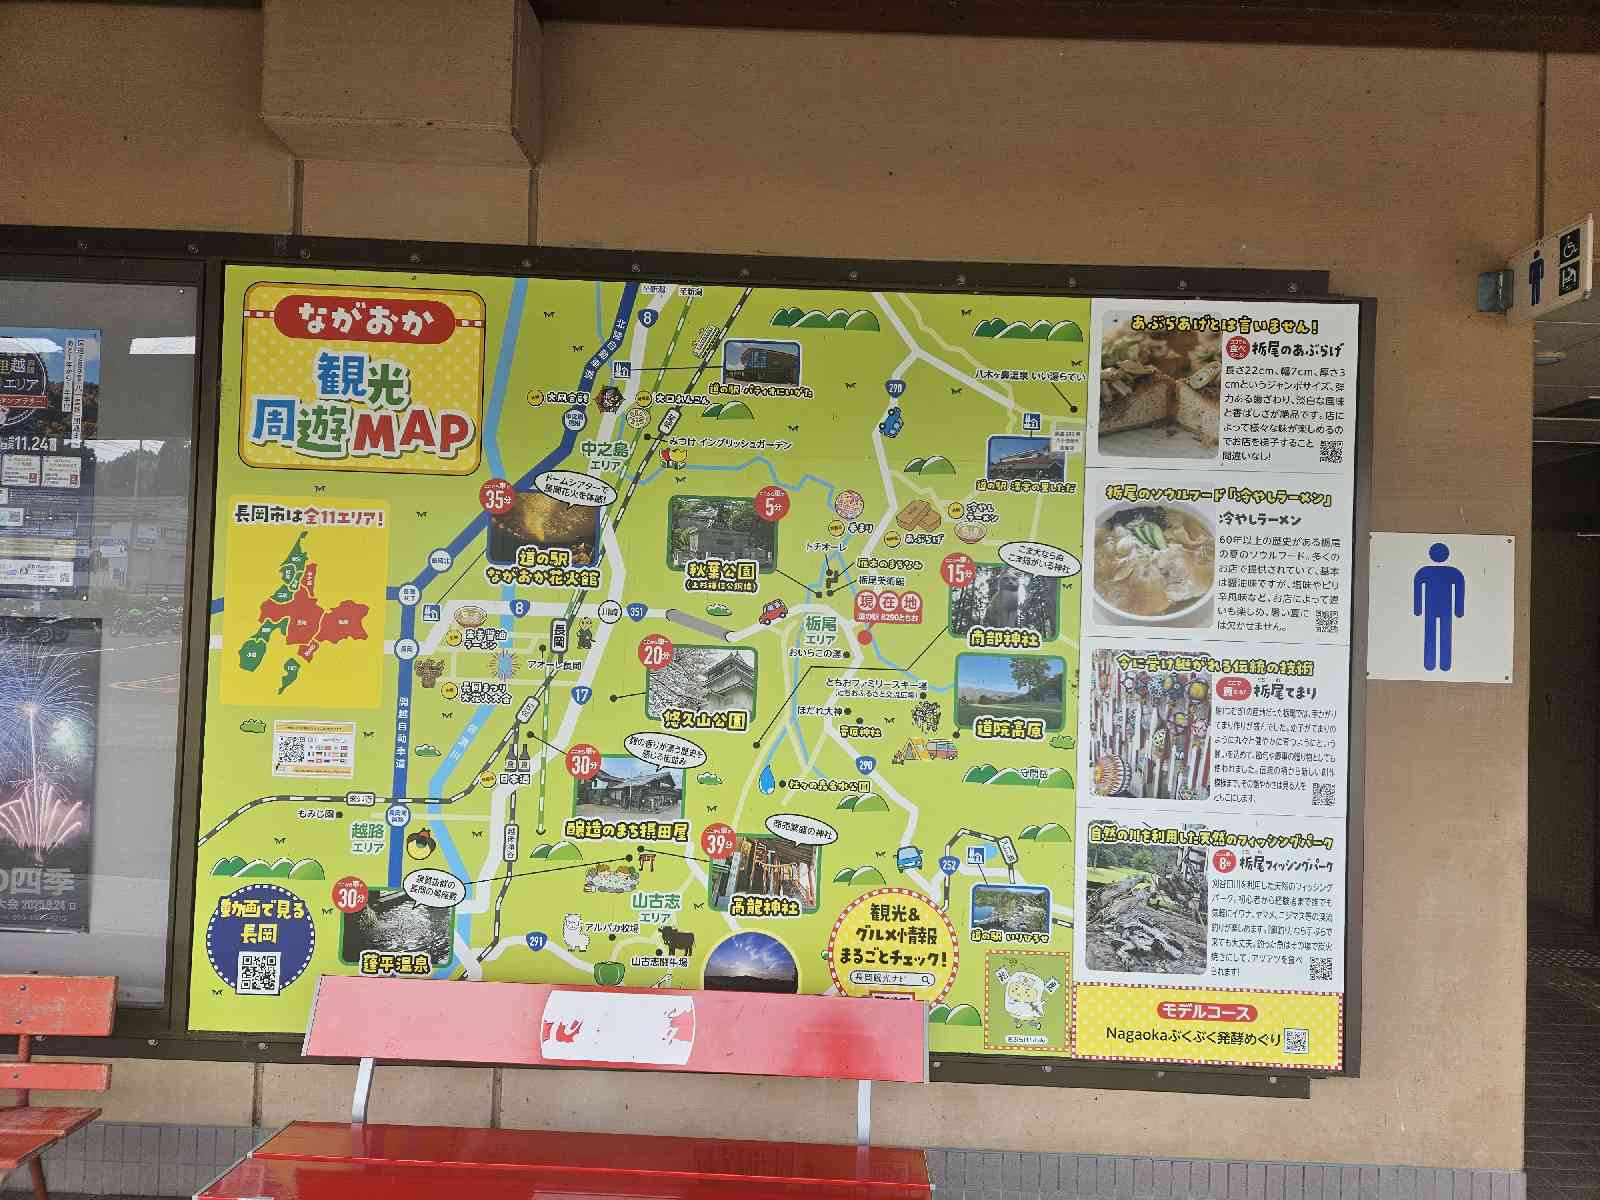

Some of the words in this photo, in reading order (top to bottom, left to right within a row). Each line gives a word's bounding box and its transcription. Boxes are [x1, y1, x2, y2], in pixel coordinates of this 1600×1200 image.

[299, 302, 434, 336] ながおか
[643, 311, 652, 325] 8
[1131, 315, 1319, 335] あぶらあげとは言いません!
[1252, 340, 1345, 358] 栃尾のあぶらげ
[317, 352, 404, 405] 観光
[709, 382, 740, 395] 道の駅
[889, 384, 902, 393] 290
[252, 399, 470, 453] 周遊MAP
[582, 441, 628, 457] 中之島
[669, 438, 696, 446] みつけ
[701, 439, 792, 449] イングリッシュガーデン
[591, 460, 622, 471] エリア
[546, 473, 610, 494] ドームシアターで
[485, 489, 512, 508] 35分
[1106, 484, 1332, 507] 栃尾のソウルフード「冷やしラーメン」
[235, 504, 384, 528] 長岡市は全11エリア!
[765, 497, 783, 516] 5分
[1218, 512, 1301, 526] 冷やしラーメン
[806, 543, 847, 551] トチオーレ
[904, 534, 944, 545] あぶらげ
[519, 548, 569, 567] 道の駅
[487, 567, 600, 586] ながおか花火館
[688, 560, 756, 580] 秋葉公園
[947, 563, 973, 583] 15分
[515, 601, 524, 614] 8
[858, 592, 920, 610] 現在地
[630, 607, 643, 617] 351
[806, 616, 837, 632] 栃尾
[553, 624, 566, 648] 長岡
[806, 635, 836, 645] エリア
[970, 628, 1041, 648] 南部神社
[528, 660, 582, 670] アオーレ長岡
[644, 646, 670, 665] 20分
[1117, 653, 1314, 676] 今に受け継がれる伝統の技術
[461, 681, 507, 693] 長岡まつり
[575, 688, 588, 701] 17
[1253, 683, 1317, 700] 栃尾てまり
[662, 709, 747, 731] 悠久山公園
[976, 719, 1043, 739] 道院高原
[571, 755, 597, 775] 30分
[859, 761, 873, 770] 290
[500, 774, 530, 785] 日本酒
[352, 823, 384, 839] 越路
[565, 819, 690, 842] 醸造のまち摂田屋
[1090, 825, 1334, 850] 自然の川を利用した天然のフィッシングパーク
[352, 842, 384, 853] エリア
[707, 834, 732, 854] 39分
[942, 860, 956, 870] 252
[1239, 855, 1333, 873] 栃尾フィッシングパーク
[338, 889, 366, 908] 30分
[632, 893, 681, 910] 山古志
[731, 896, 800, 917] 高龍神社
[220, 899, 305, 919] 動画で見る
[640, 913, 670, 923] エリア
[870, 903, 920, 922] 観光&
[241, 924, 277, 944] 長岡
[585, 923, 638, 933] アルパカ牧場
[856, 924, 937, 945] グルメ情報
[970, 929, 1002, 943] 道の駅
[1006, 932, 1049, 944] いりひろせ
[529, 936, 543, 946] 291
[361, 952, 431, 975] 蓬平温泉
[839, 948, 948, 967] まるごとチェック!
[1162, 1003, 1251, 1021] モデルコース
[1106, 1027, 1281, 1047] Nagaokaぶくぶく発酵めぐり
